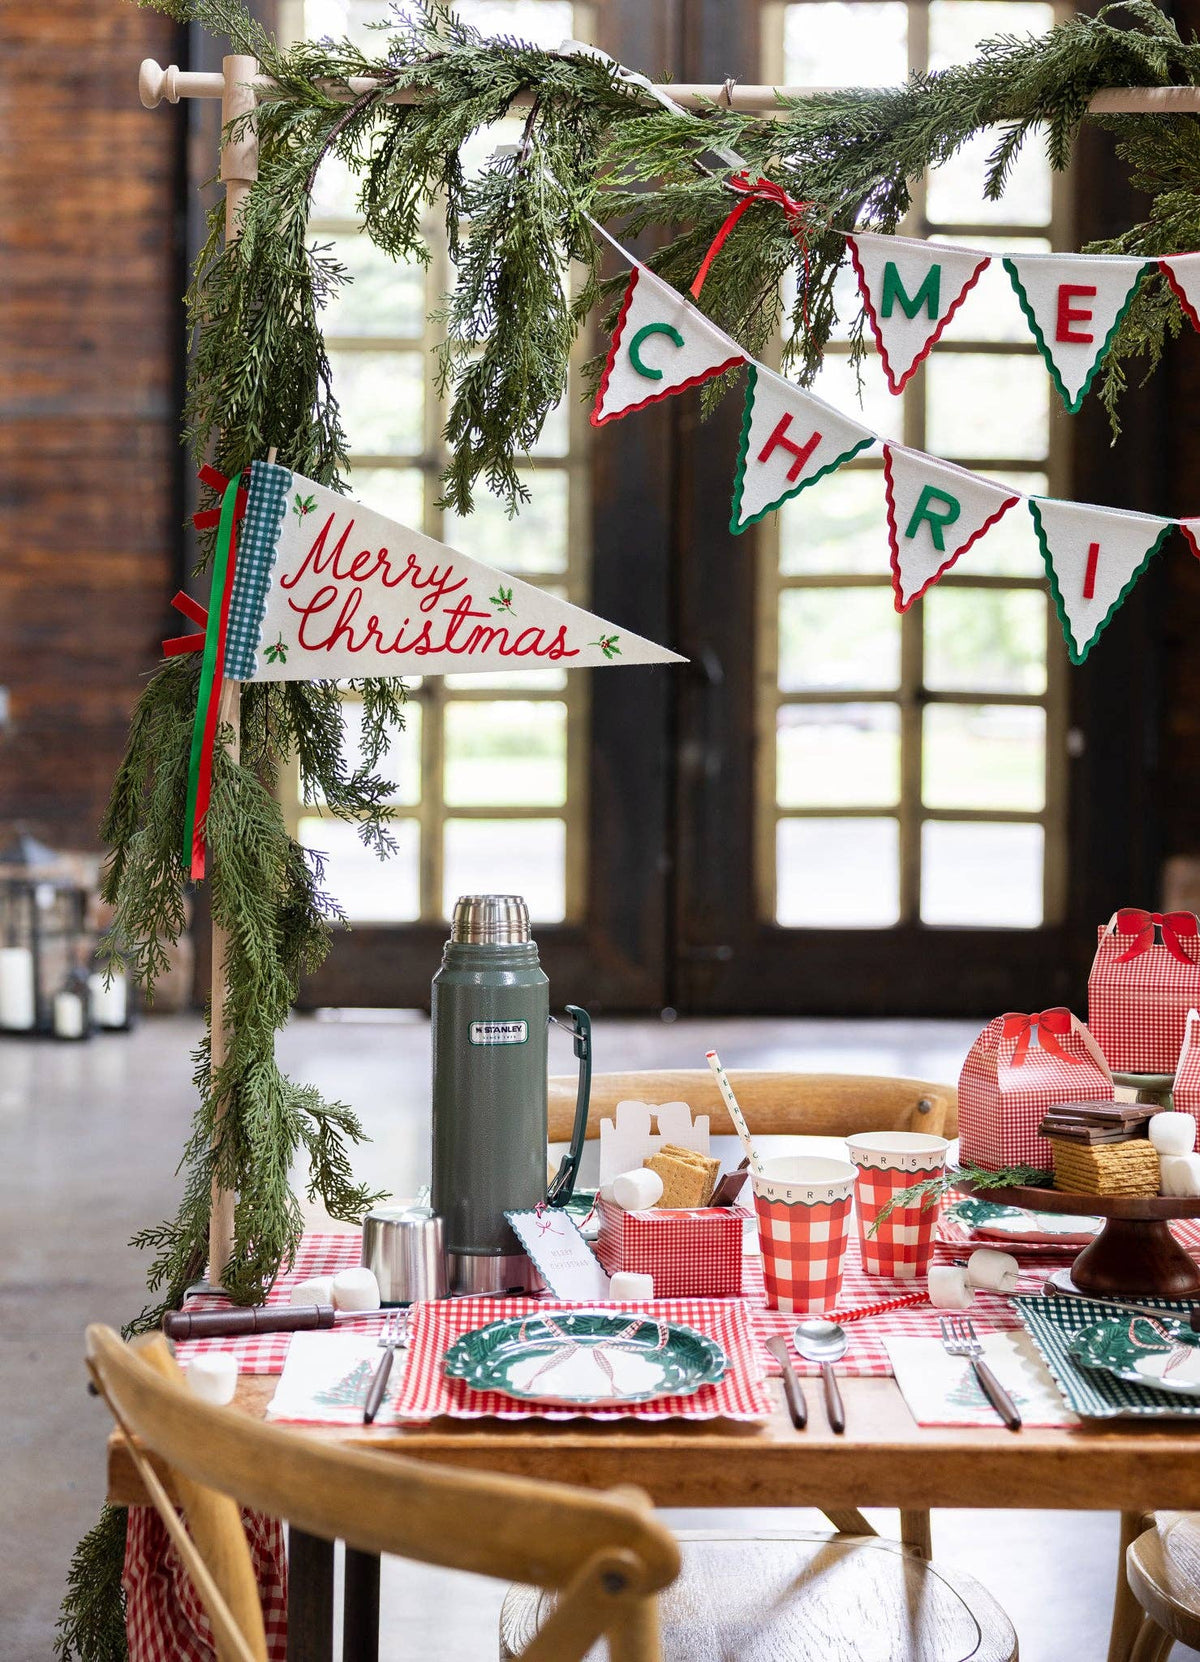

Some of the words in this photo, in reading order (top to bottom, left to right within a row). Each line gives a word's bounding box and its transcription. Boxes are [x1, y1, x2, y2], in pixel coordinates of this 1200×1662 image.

[280, 512, 469, 613] Merry
[287, 585, 581, 659] Christmas
[484, 1025, 522, 1034] STANLEY
[767, 1186, 848, 1199] MERRY
